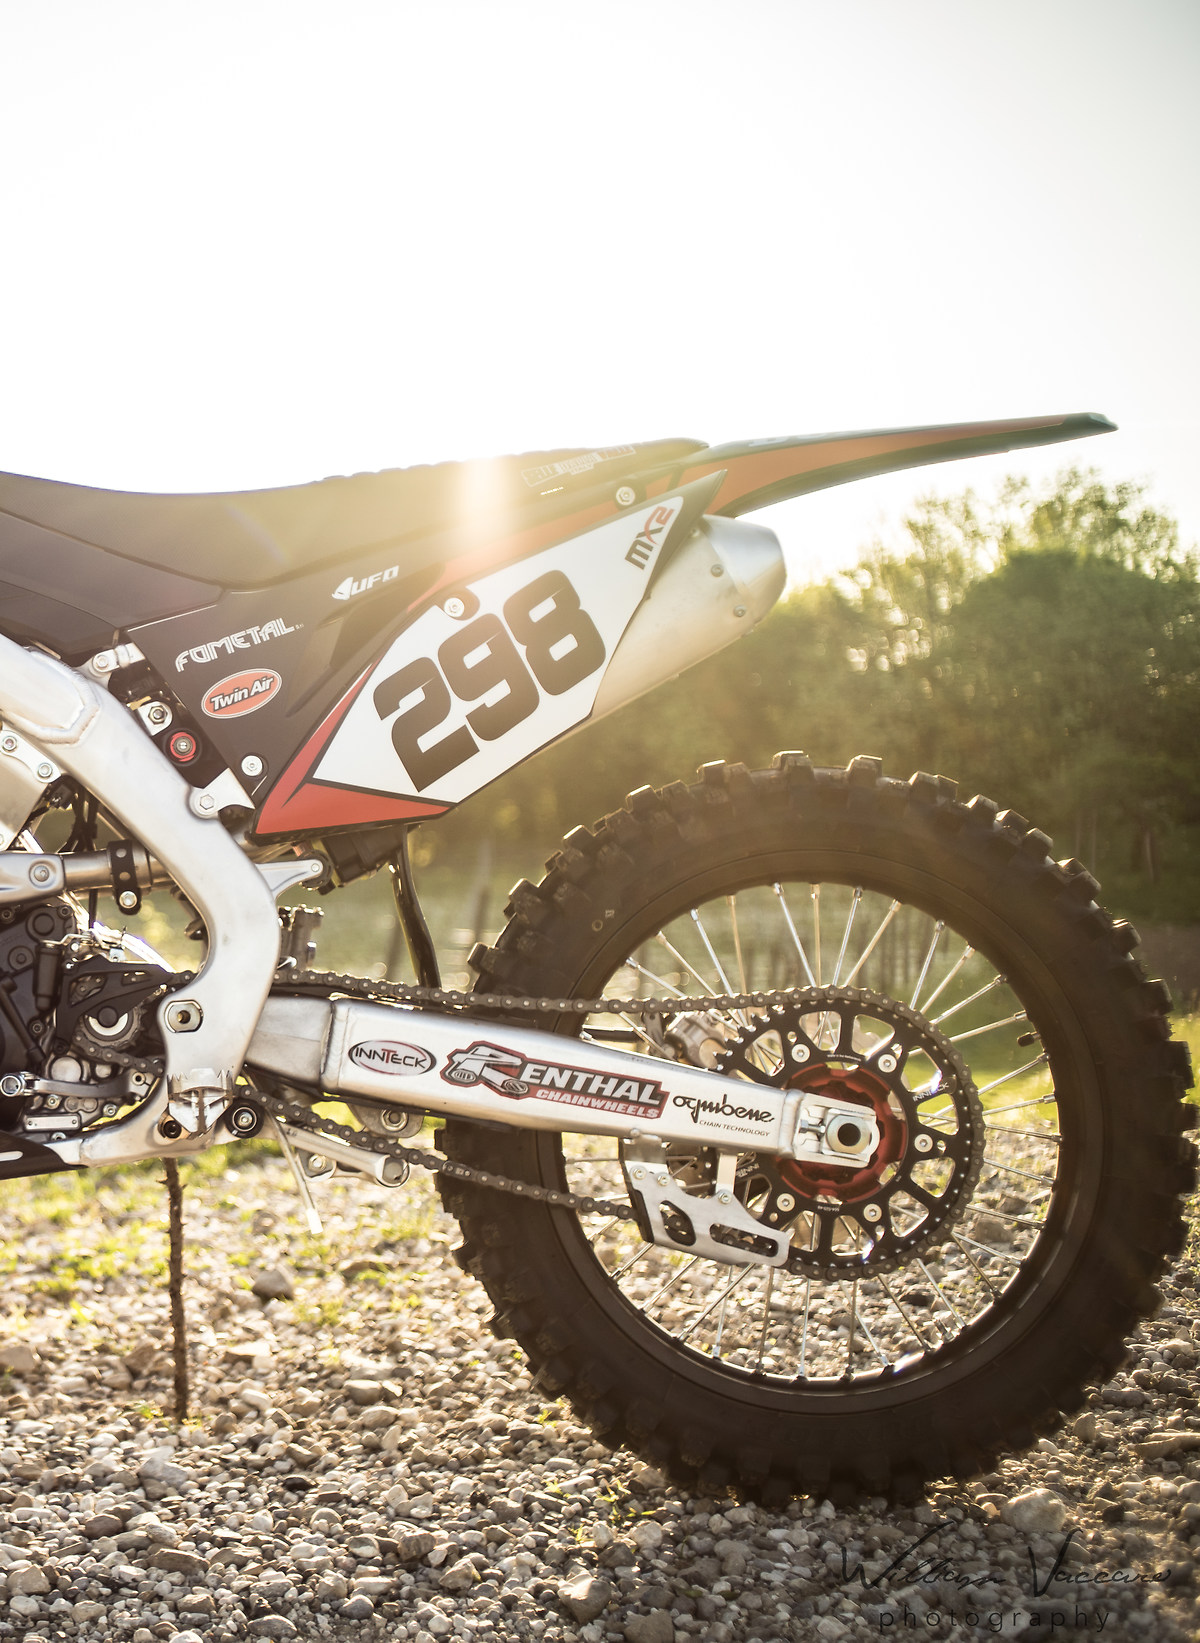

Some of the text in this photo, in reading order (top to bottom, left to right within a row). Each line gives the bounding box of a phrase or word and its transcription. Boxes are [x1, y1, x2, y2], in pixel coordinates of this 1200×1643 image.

[625, 505, 675, 571] MX2
[352, 565, 400, 594] UFO
[175, 618, 295, 672] FOMETAL
[211, 676, 275, 711] Twin Air
[372, 569, 606, 793] 298
[355, 1046, 427, 1069] INNTECK
[448, 1046, 662, 1105] RENTHAL
[536, 1088, 660, 1119] CHAINWHEELS
[699, 1119, 770, 1137] CHAIN TECHNOLOGY
